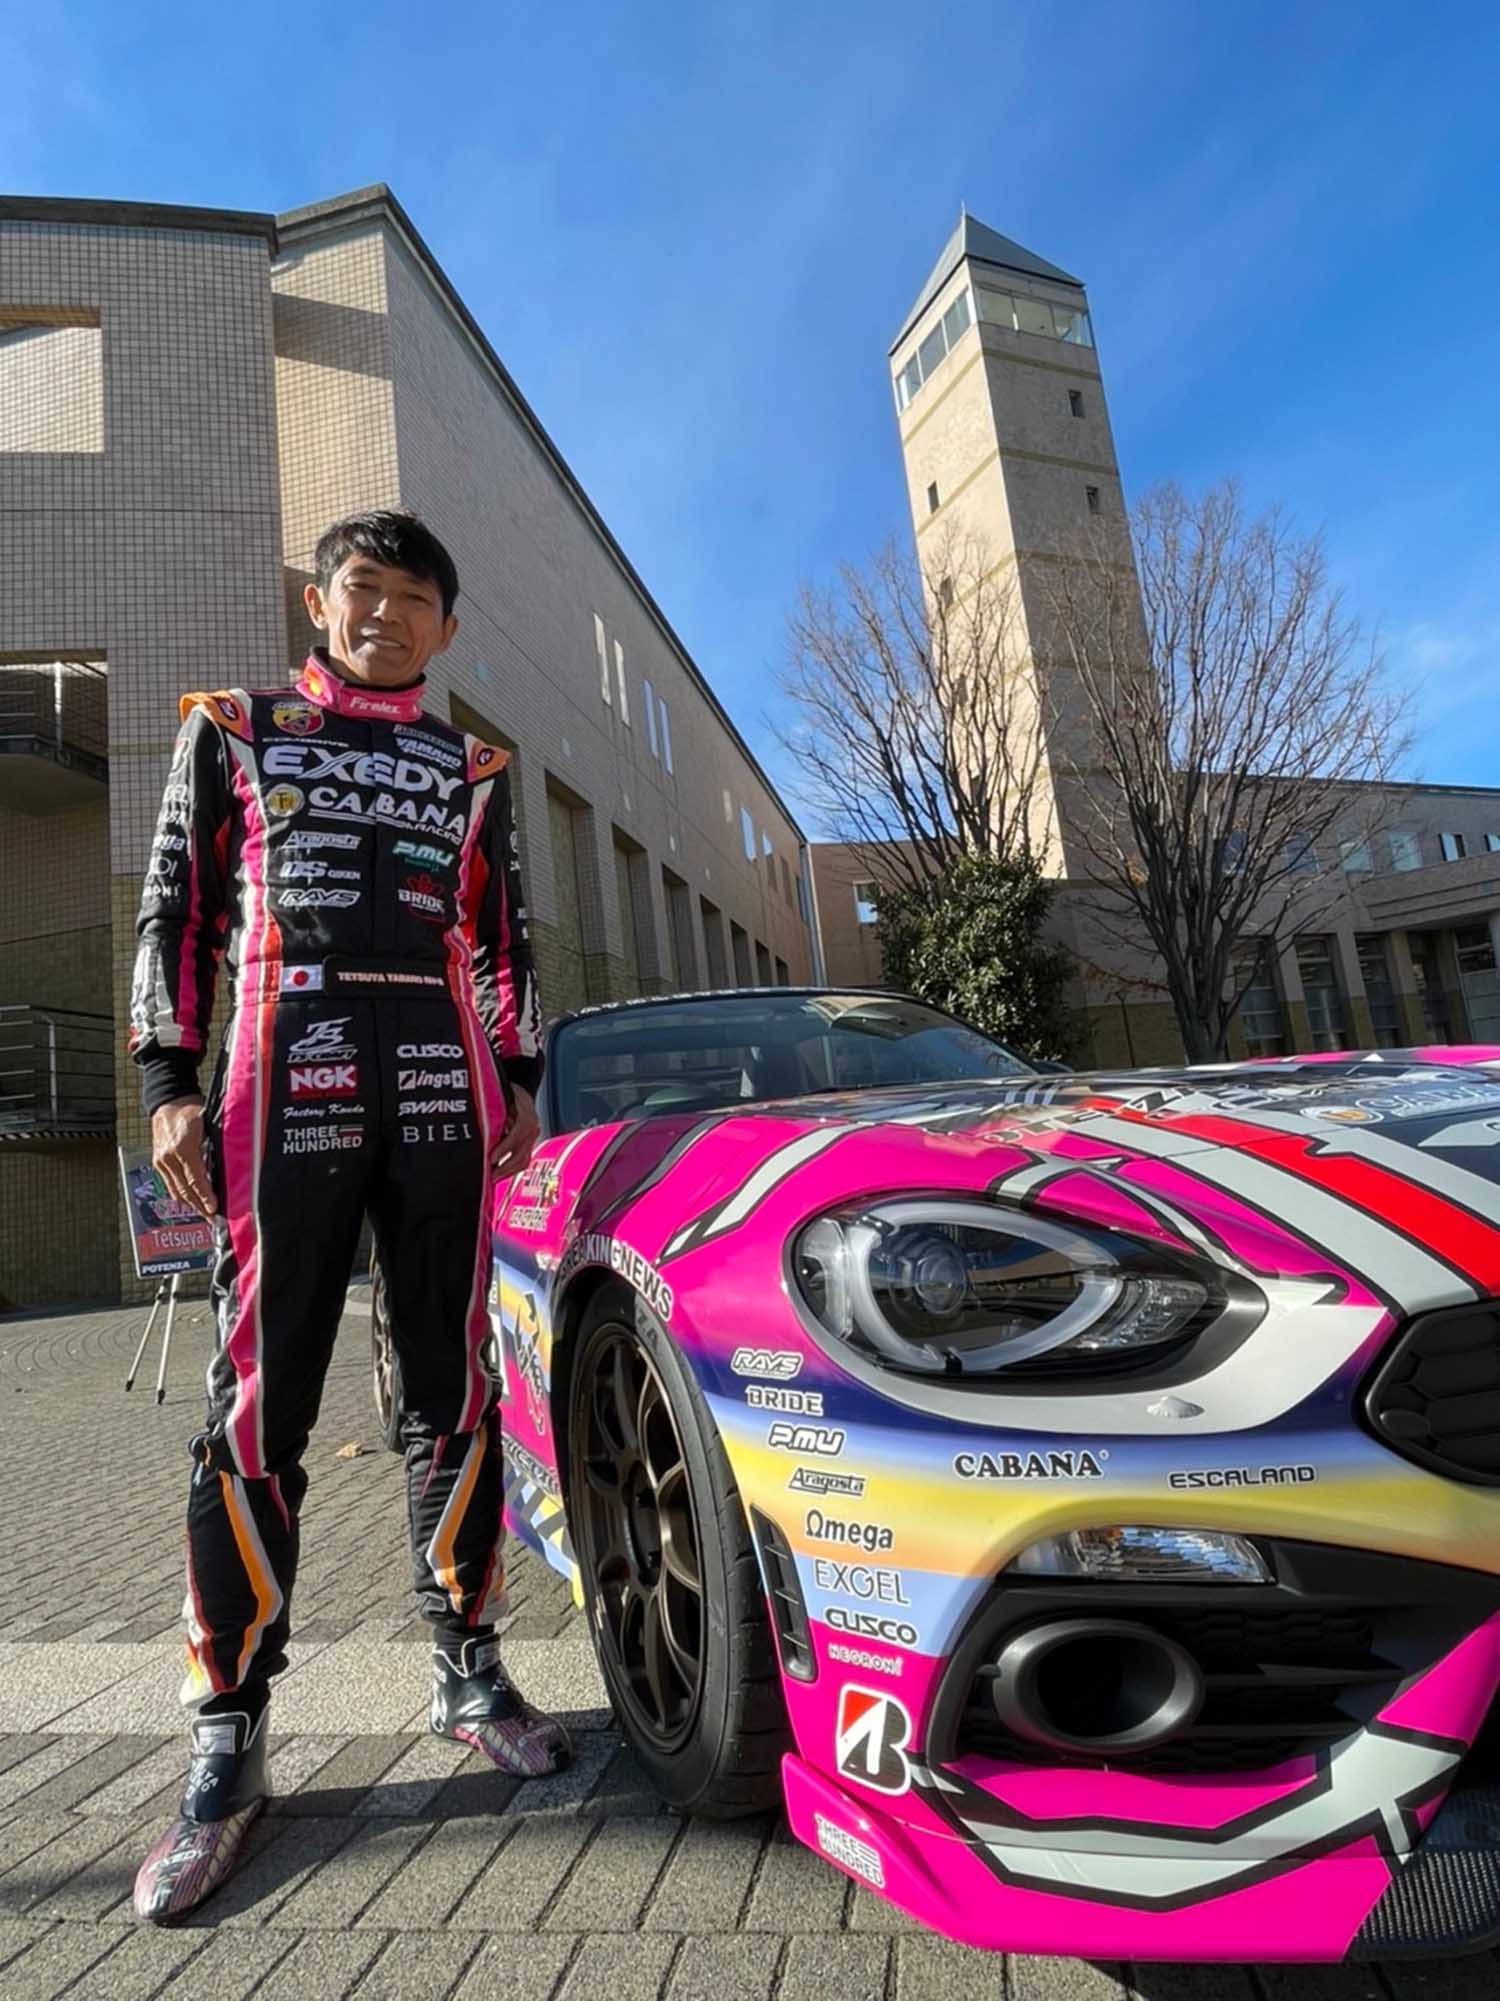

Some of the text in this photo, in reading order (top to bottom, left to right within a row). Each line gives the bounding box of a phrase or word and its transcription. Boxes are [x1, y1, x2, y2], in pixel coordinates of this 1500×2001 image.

[262, 744, 464, 801] EXEDY
[309, 786, 466, 837] CABANA
[278, 887, 361, 908] RAYS
[337, 971, 386, 984] TETSUYA
[397, 1044, 464, 1059] CUSCO
[289, 1065, 357, 1092] NGK
[282, 1107, 326, 1119] Factory
[397, 1099, 467, 1116] SWANS
[282, 1135, 363, 1155] HUNDRED
[283, 1125, 339, 1142] THREE
[142, 1260, 191, 1275] POTENZA
[733, 1350, 801, 1376] RAYS
[748, 1387, 824, 1416] BRIDE
[953, 1450, 1103, 1480] CABANA
[1168, 1465, 1316, 1490] ESCALAND
[788, 1467, 867, 1497] Aragosta
[814, 1558, 910, 1606] EXGEL
[825, 1607, 918, 1646] CUSCO
[815, 1815, 858, 1856] THREE
